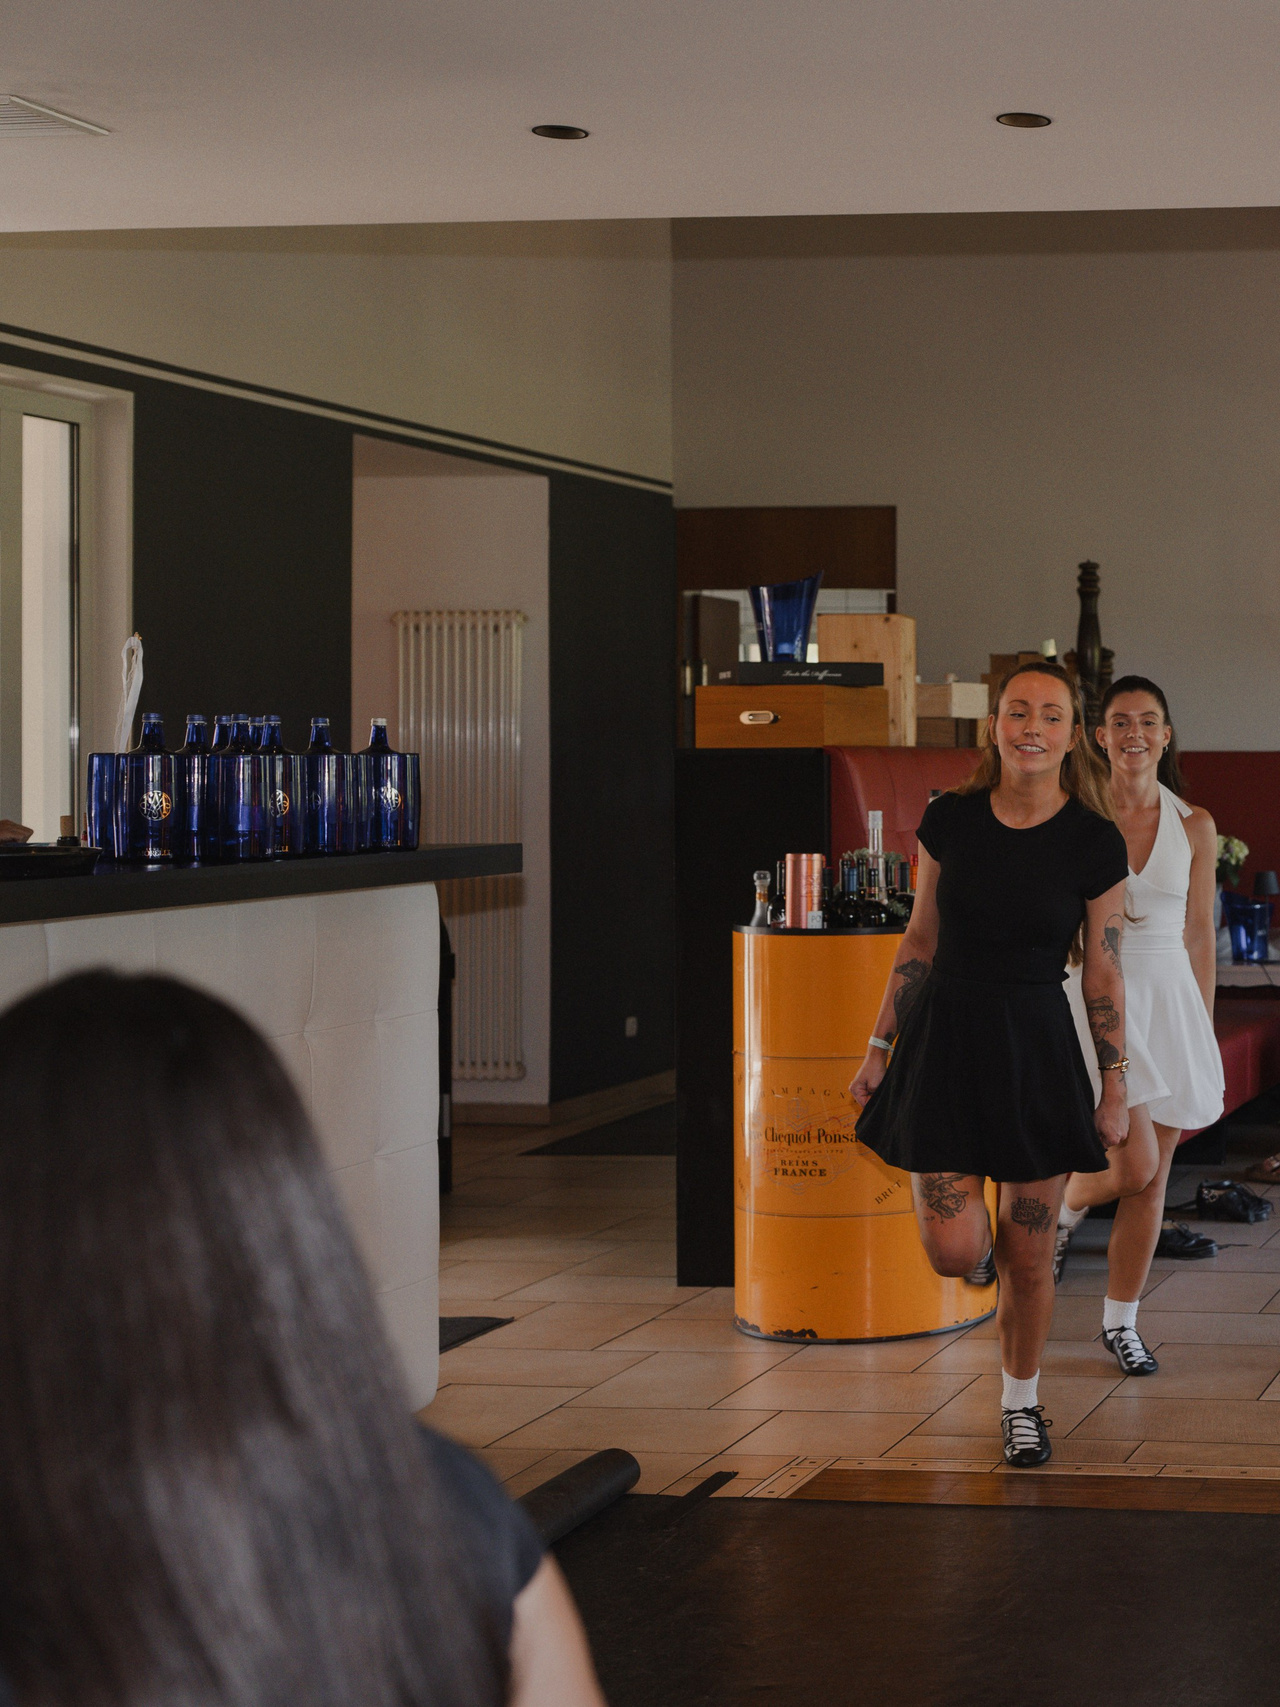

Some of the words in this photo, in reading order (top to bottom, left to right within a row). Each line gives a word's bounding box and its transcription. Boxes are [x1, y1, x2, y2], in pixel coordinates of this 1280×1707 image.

[817, 1128, 860, 1144] Ponsa
[774, 1168, 827, 1177] FRANCE
[874, 1180, 902, 1204] BRUT
